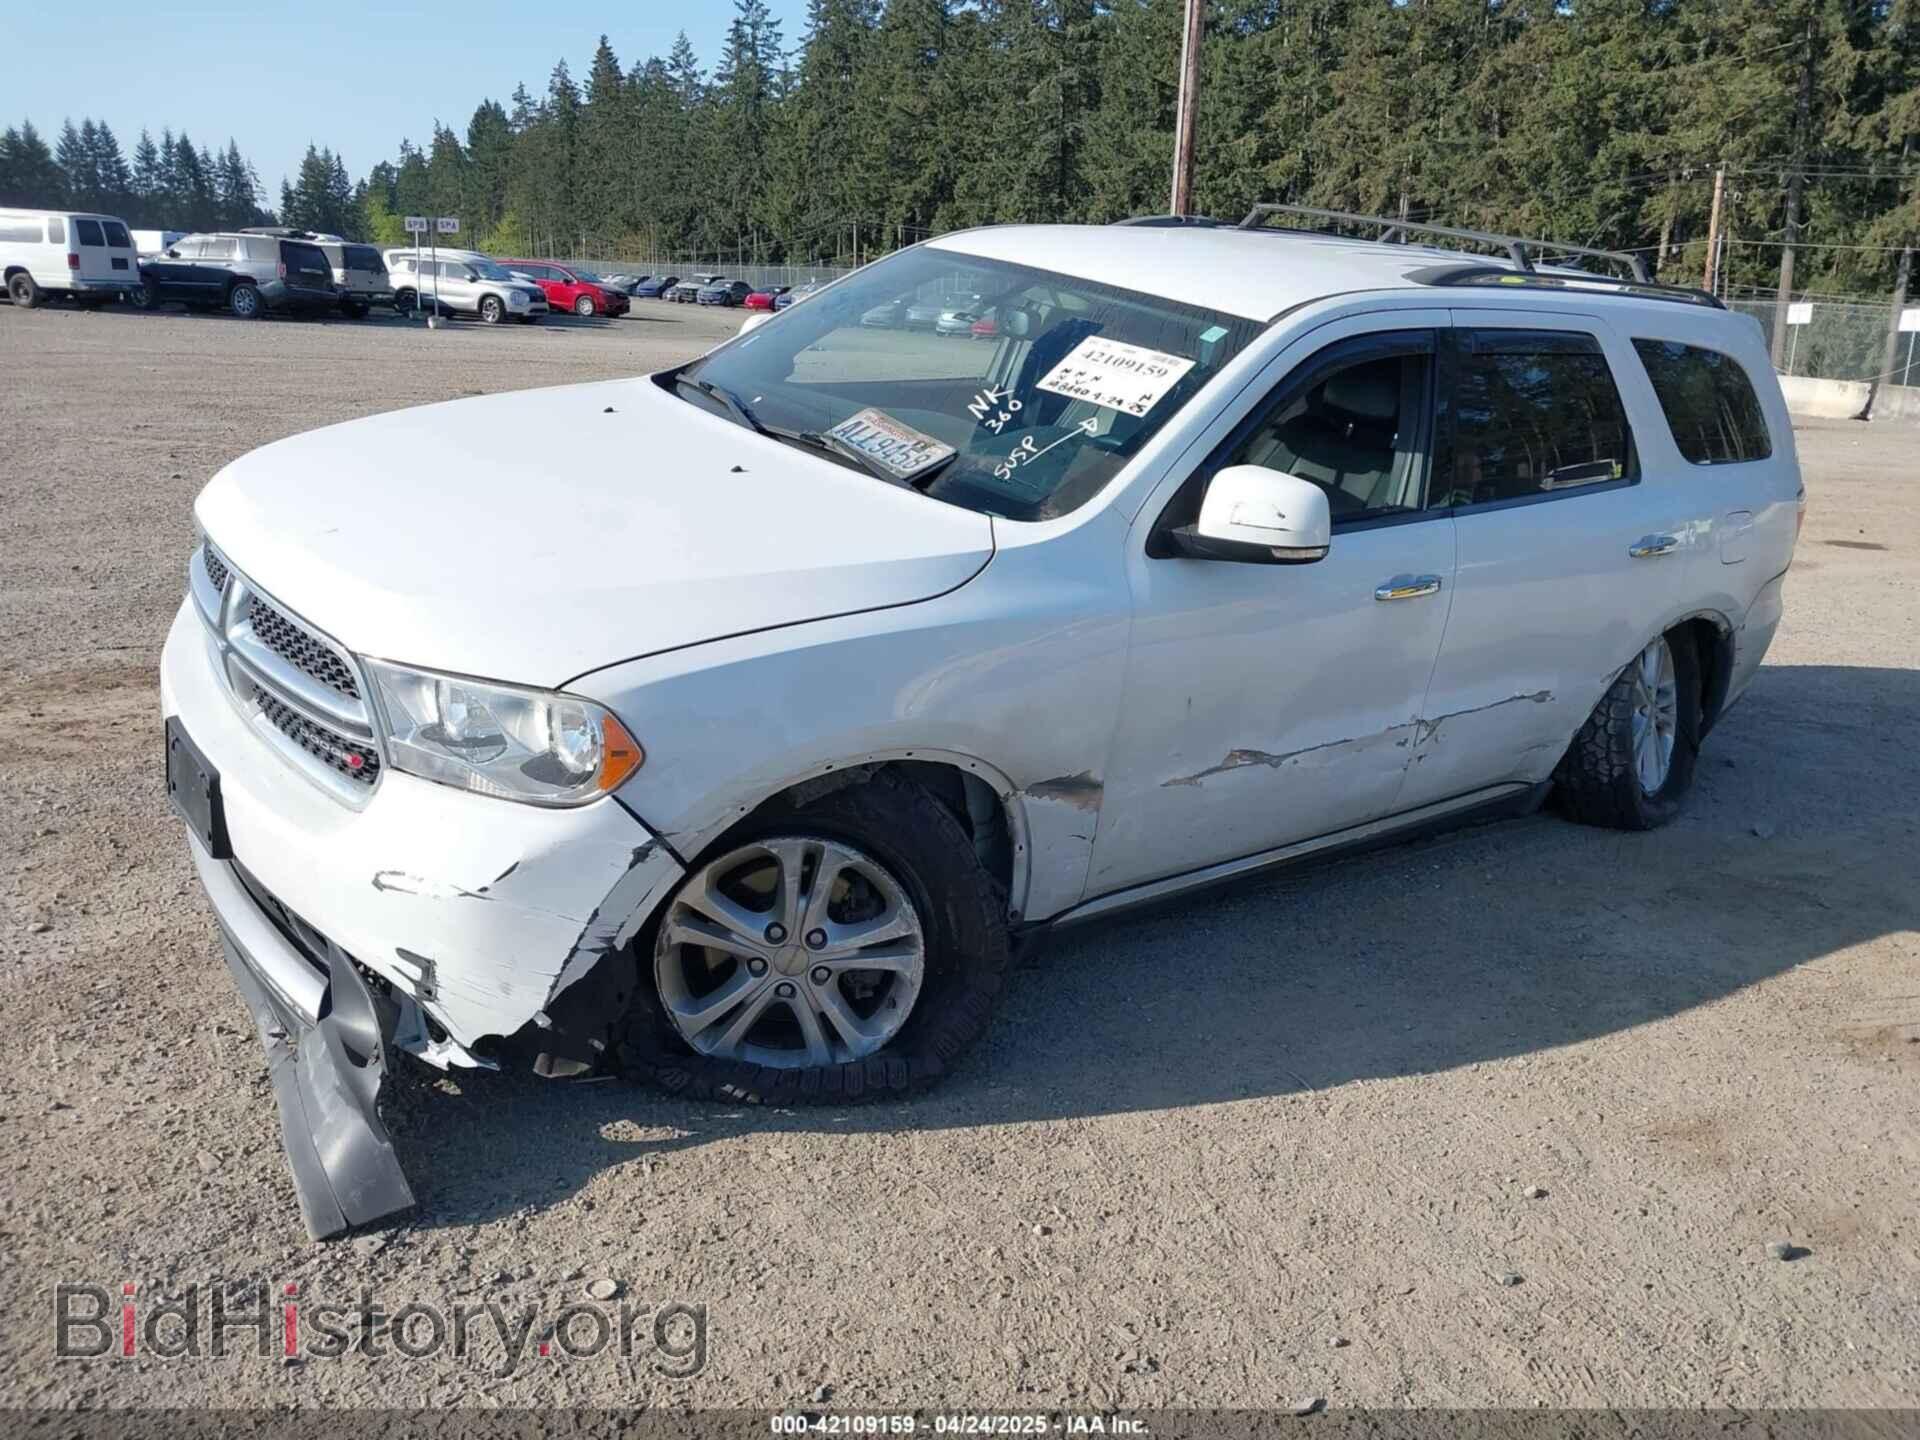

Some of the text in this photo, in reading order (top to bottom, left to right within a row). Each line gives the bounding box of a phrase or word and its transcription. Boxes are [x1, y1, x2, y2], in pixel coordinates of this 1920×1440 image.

[1081, 349, 1169, 379] 42109159
[985, 399, 1023, 434] 360
[994, 435, 1038, 479] SUSP
